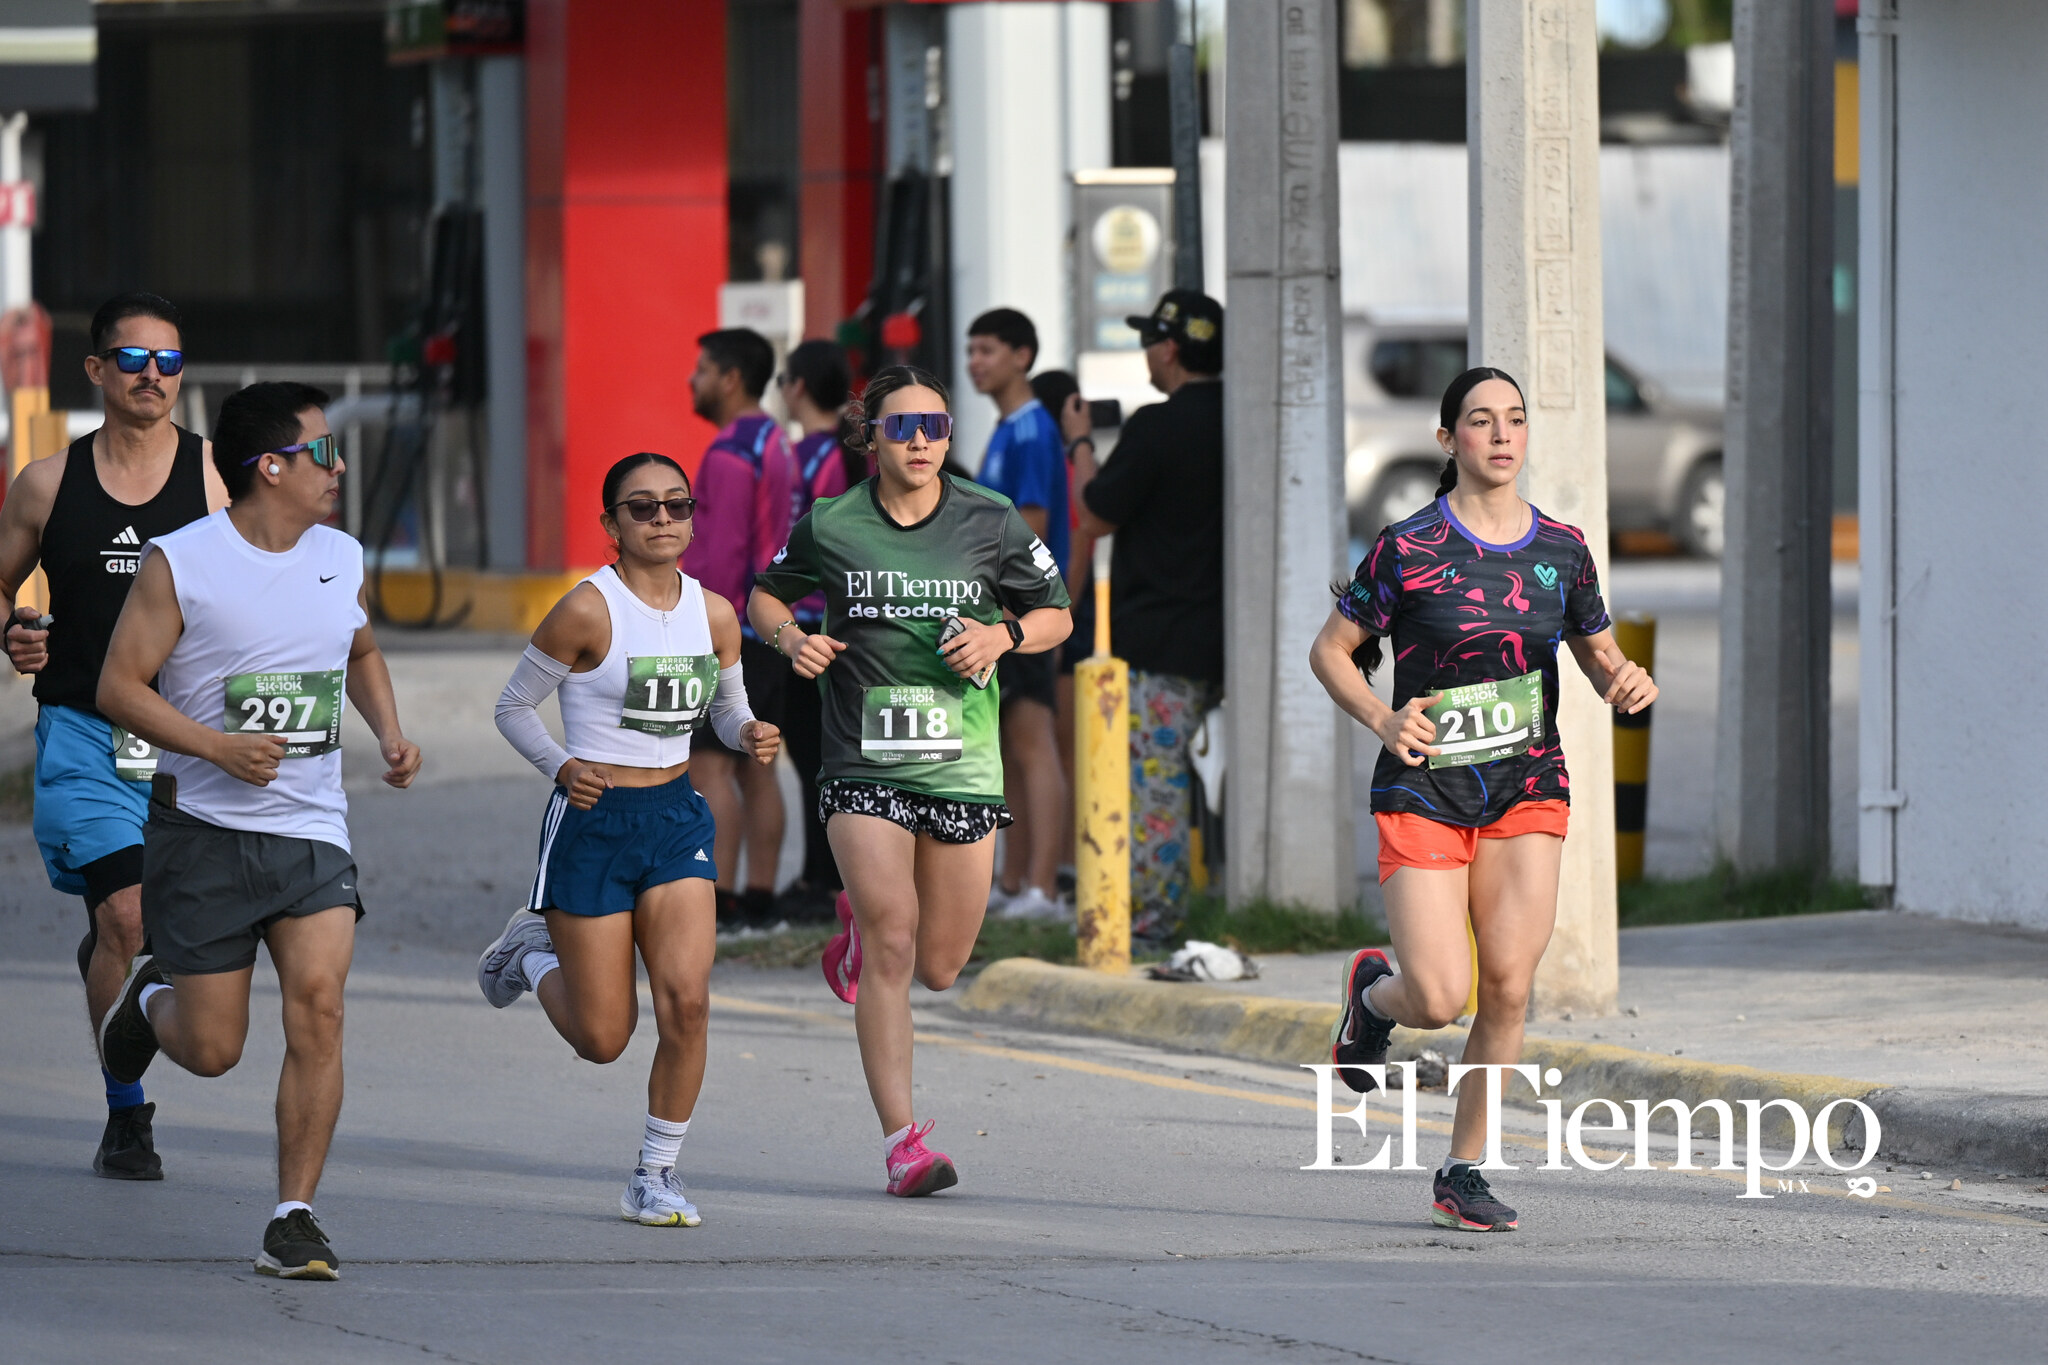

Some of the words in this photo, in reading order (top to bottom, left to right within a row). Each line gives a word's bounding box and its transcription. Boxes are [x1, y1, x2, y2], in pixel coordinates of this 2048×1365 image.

[844, 571, 874, 597] El
[878, 571, 981, 605] Tiempo
[849, 603, 878, 618] de
[882, 603, 959, 618] todos
[644, 677, 703, 709] 110
[1450, 683, 1498, 696] CARRERA
[1527, 675, 1540, 685] 210
[240, 696, 317, 731] 297
[329, 689, 340, 744] MEDALLA
[879, 707, 949, 739] 118
[1440, 701, 1516, 742] 210
[1530, 687, 1542, 738] MEDALLA
